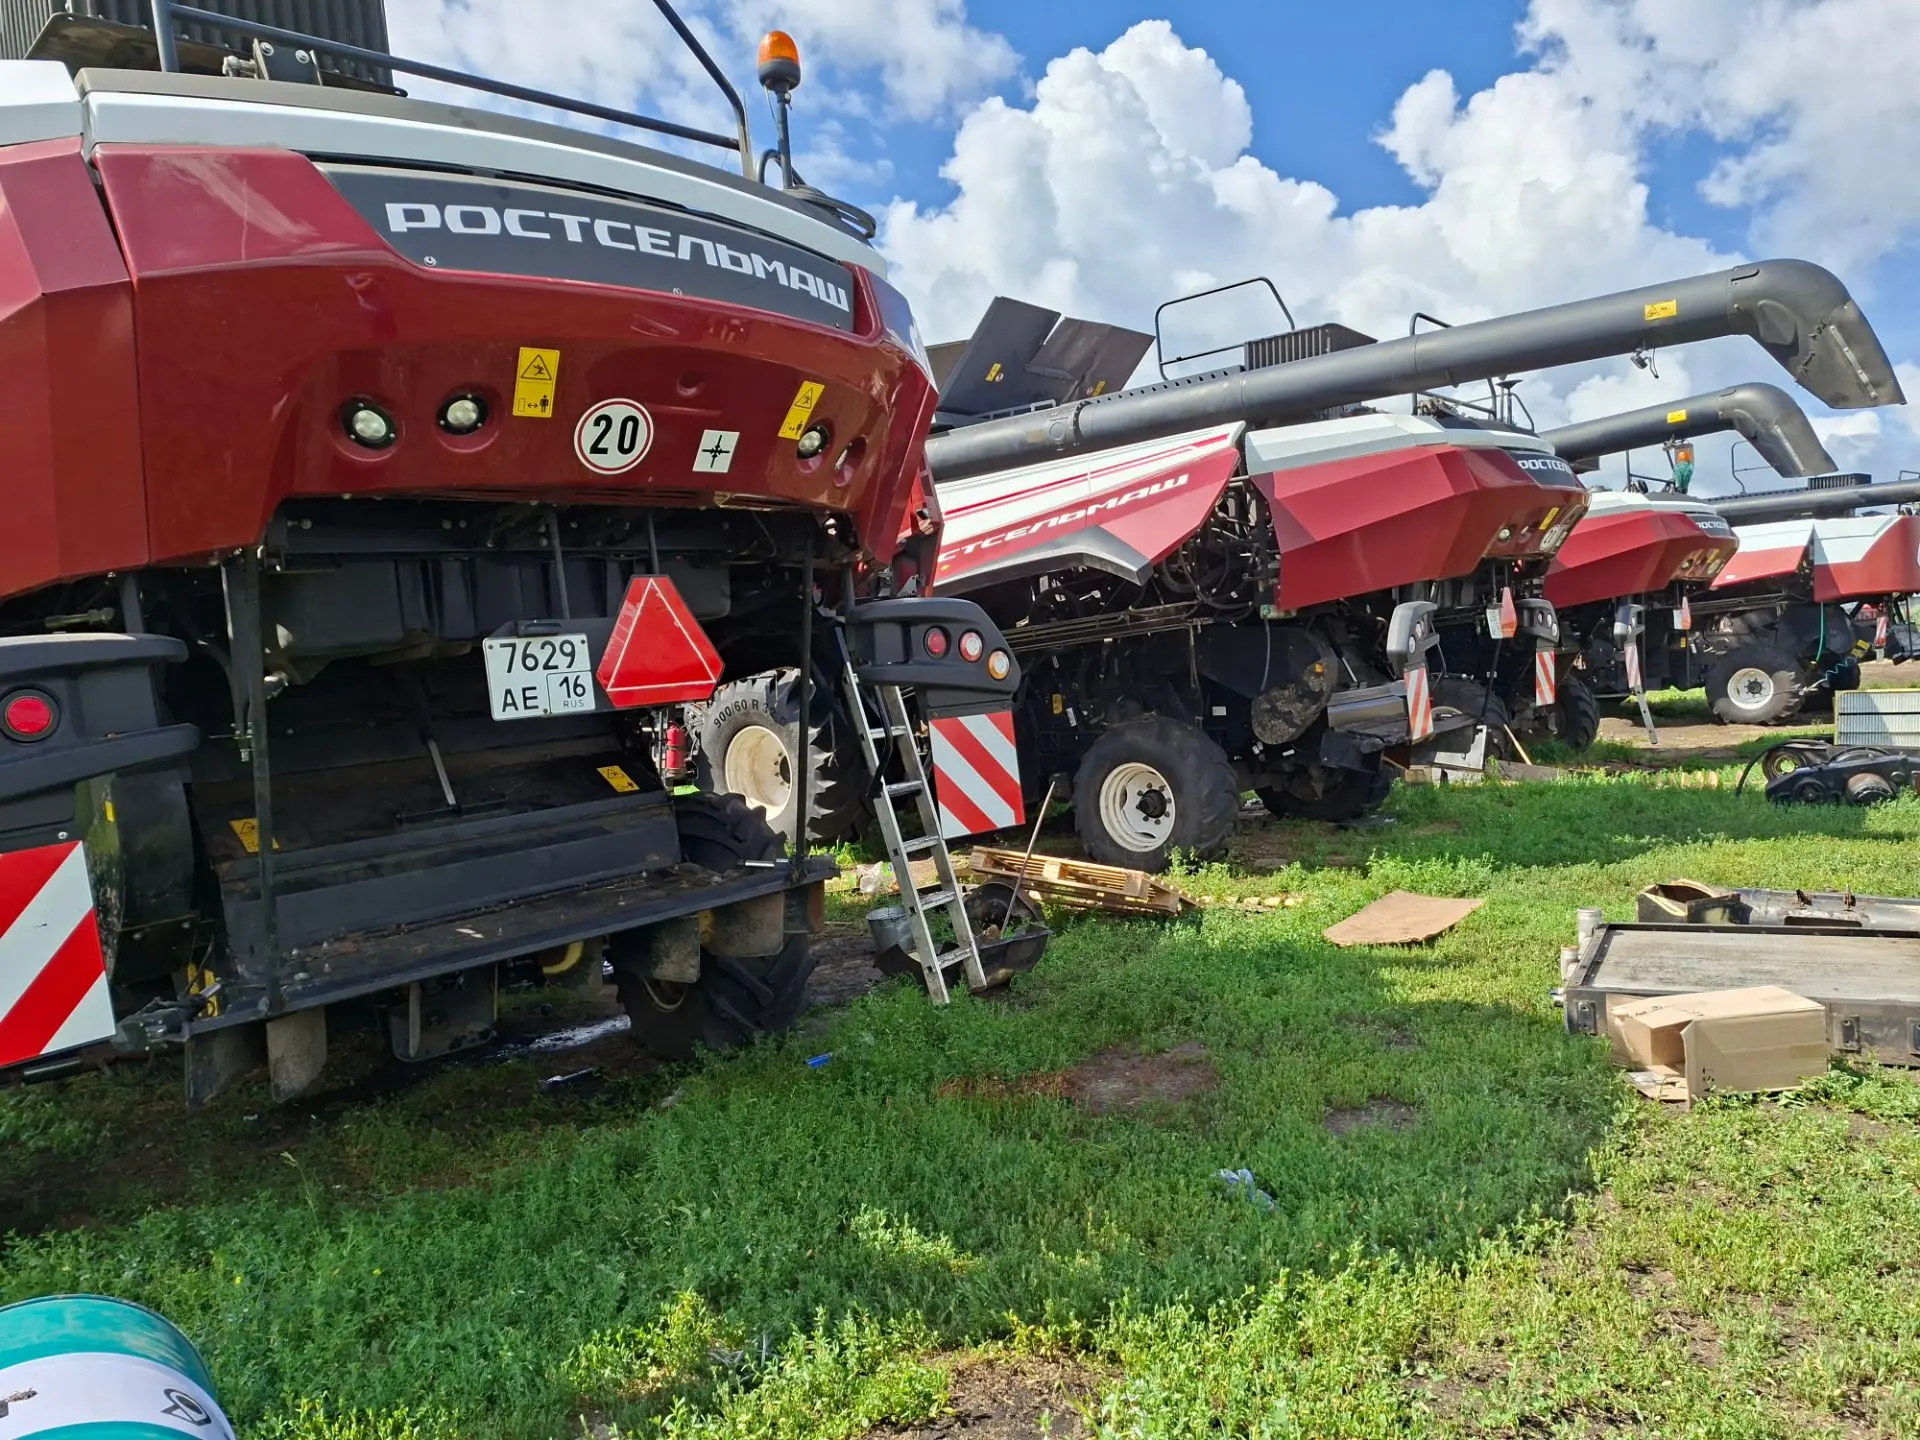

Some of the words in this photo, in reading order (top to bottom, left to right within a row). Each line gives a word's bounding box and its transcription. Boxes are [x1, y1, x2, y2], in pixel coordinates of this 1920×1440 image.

[384, 202, 850, 312] РОСТСЕЛЬМАШ
[589, 413, 640, 455] 20
[499, 639, 576, 674] 7629
[559, 675, 586, 699] 16
[563, 700, 584, 708] RUS
[713, 699, 748, 728] 900/60
[752, 699, 759, 710] R
